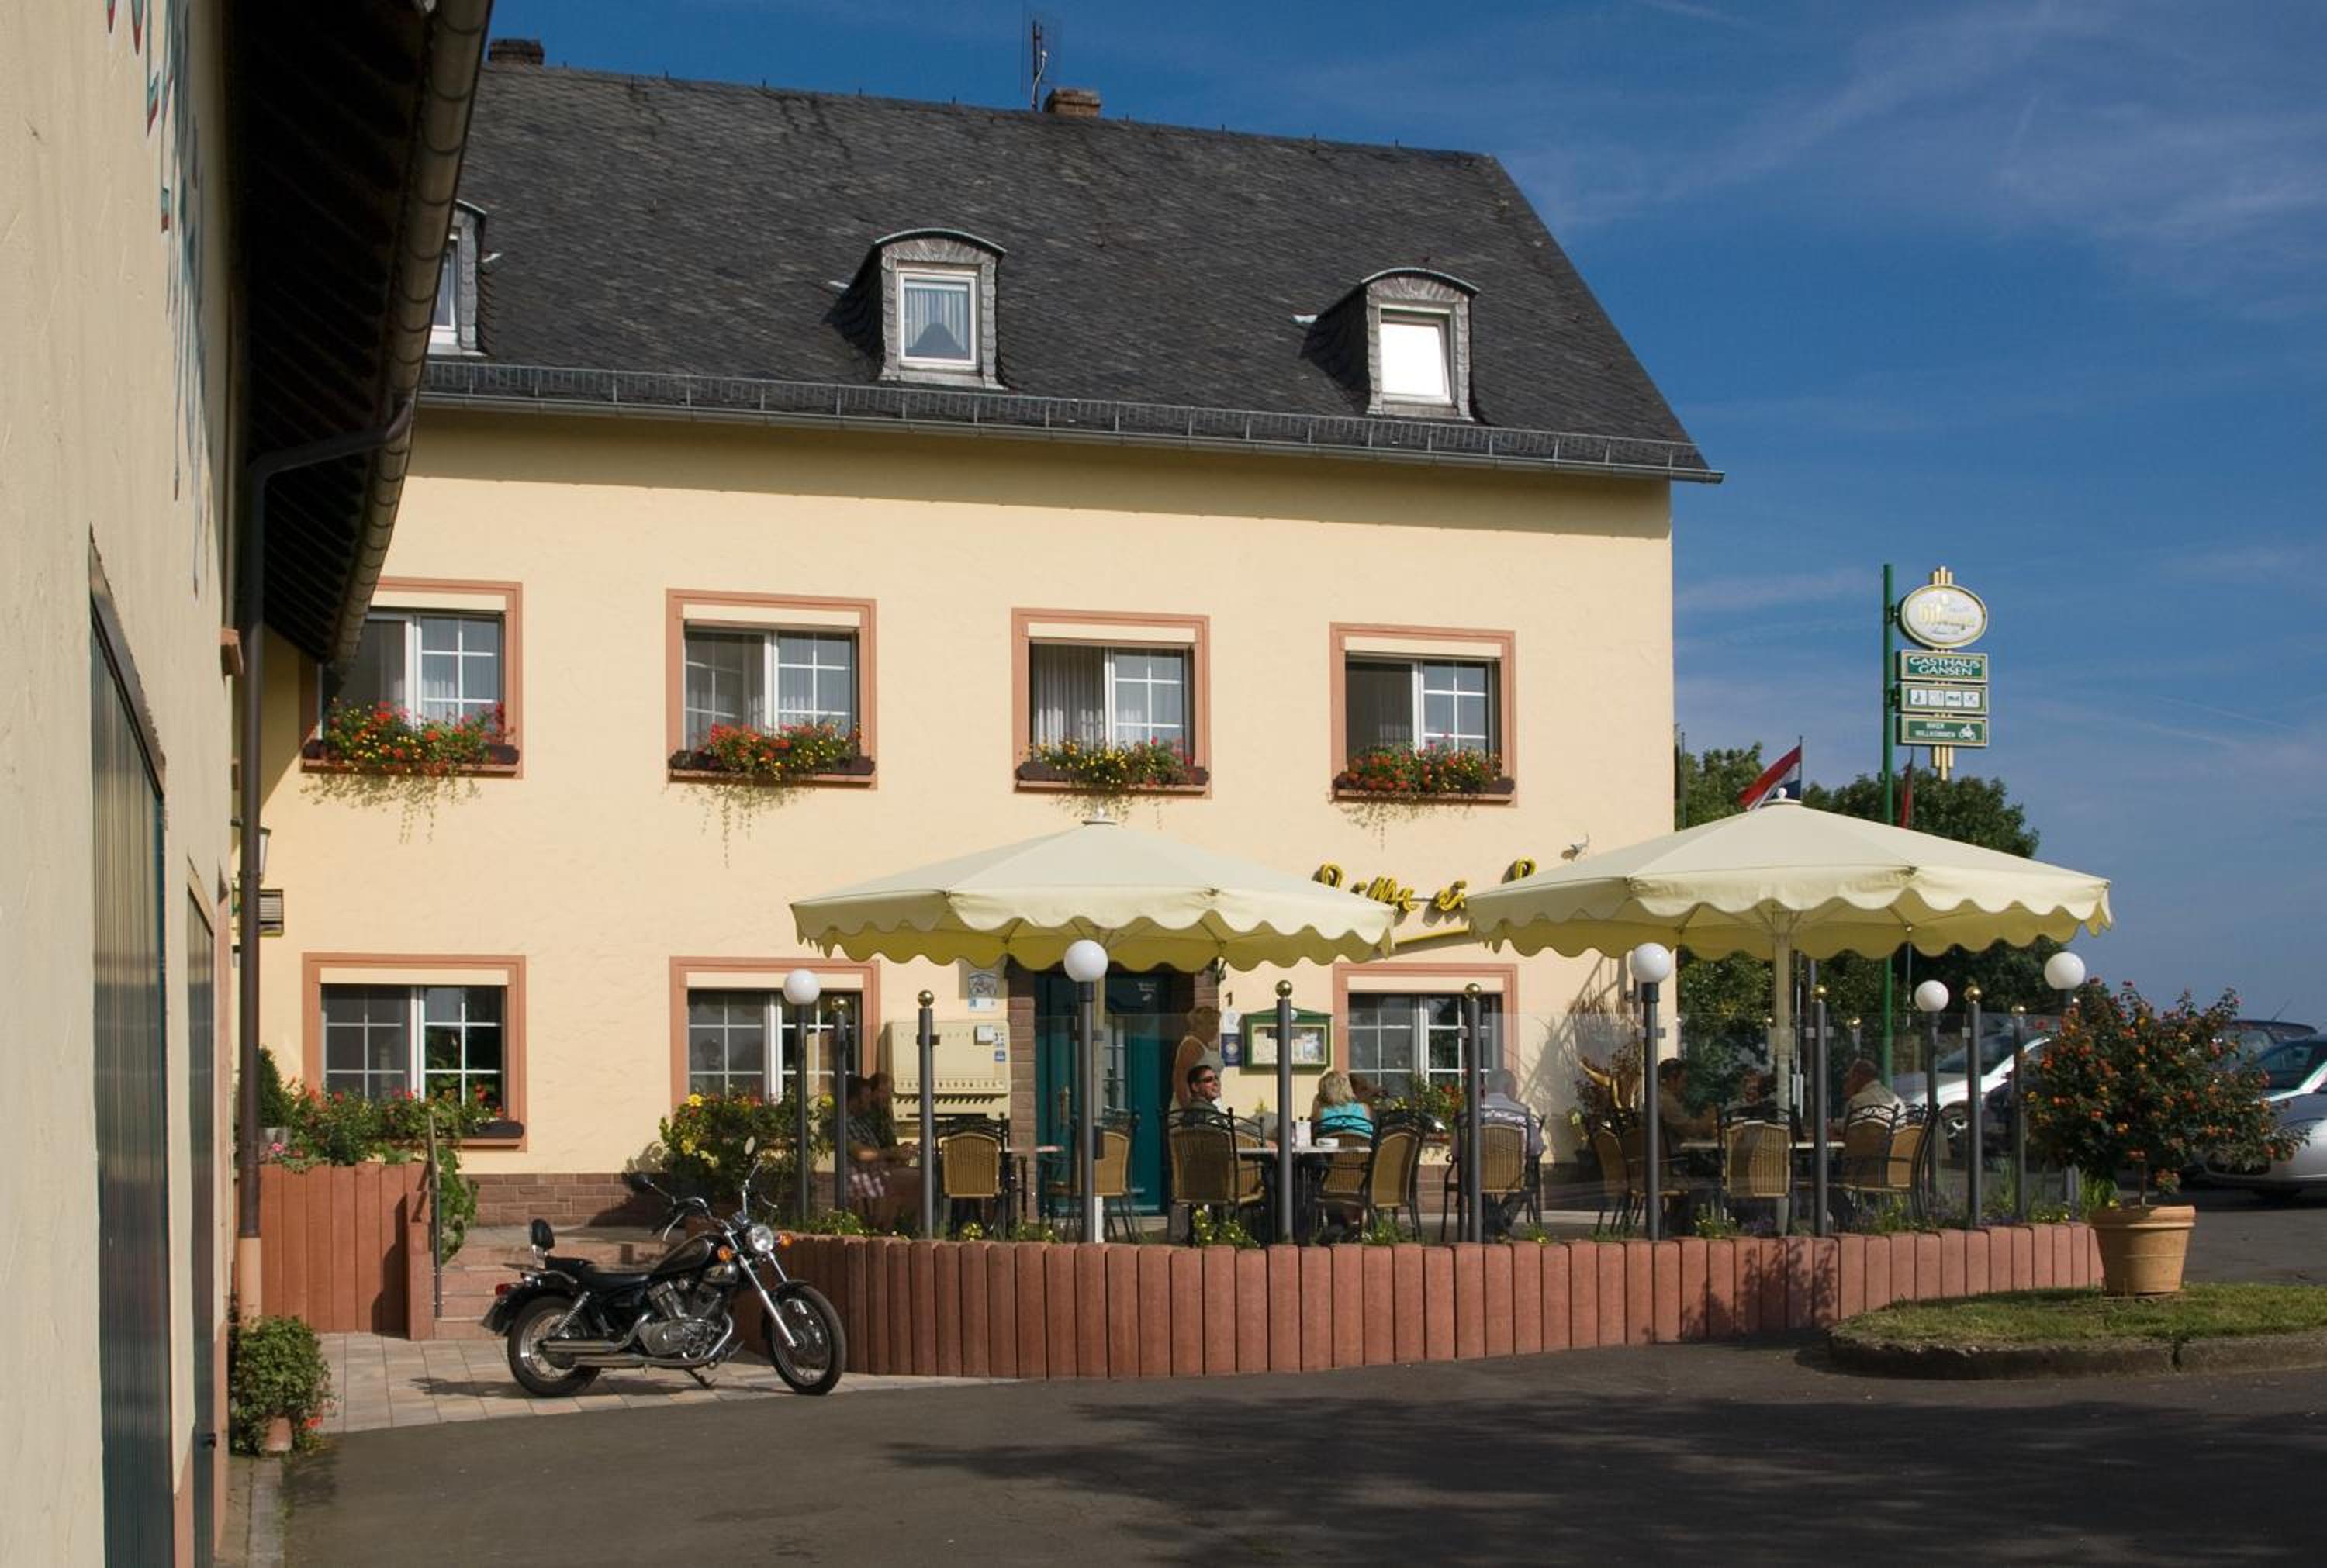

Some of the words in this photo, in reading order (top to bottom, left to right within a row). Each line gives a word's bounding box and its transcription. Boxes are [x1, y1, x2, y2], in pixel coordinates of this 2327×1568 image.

[1910, 657, 1980, 668] GASTHAUS
[1918, 665, 1973, 675] GANSEN
[1225, 992, 1233, 1007] 1
